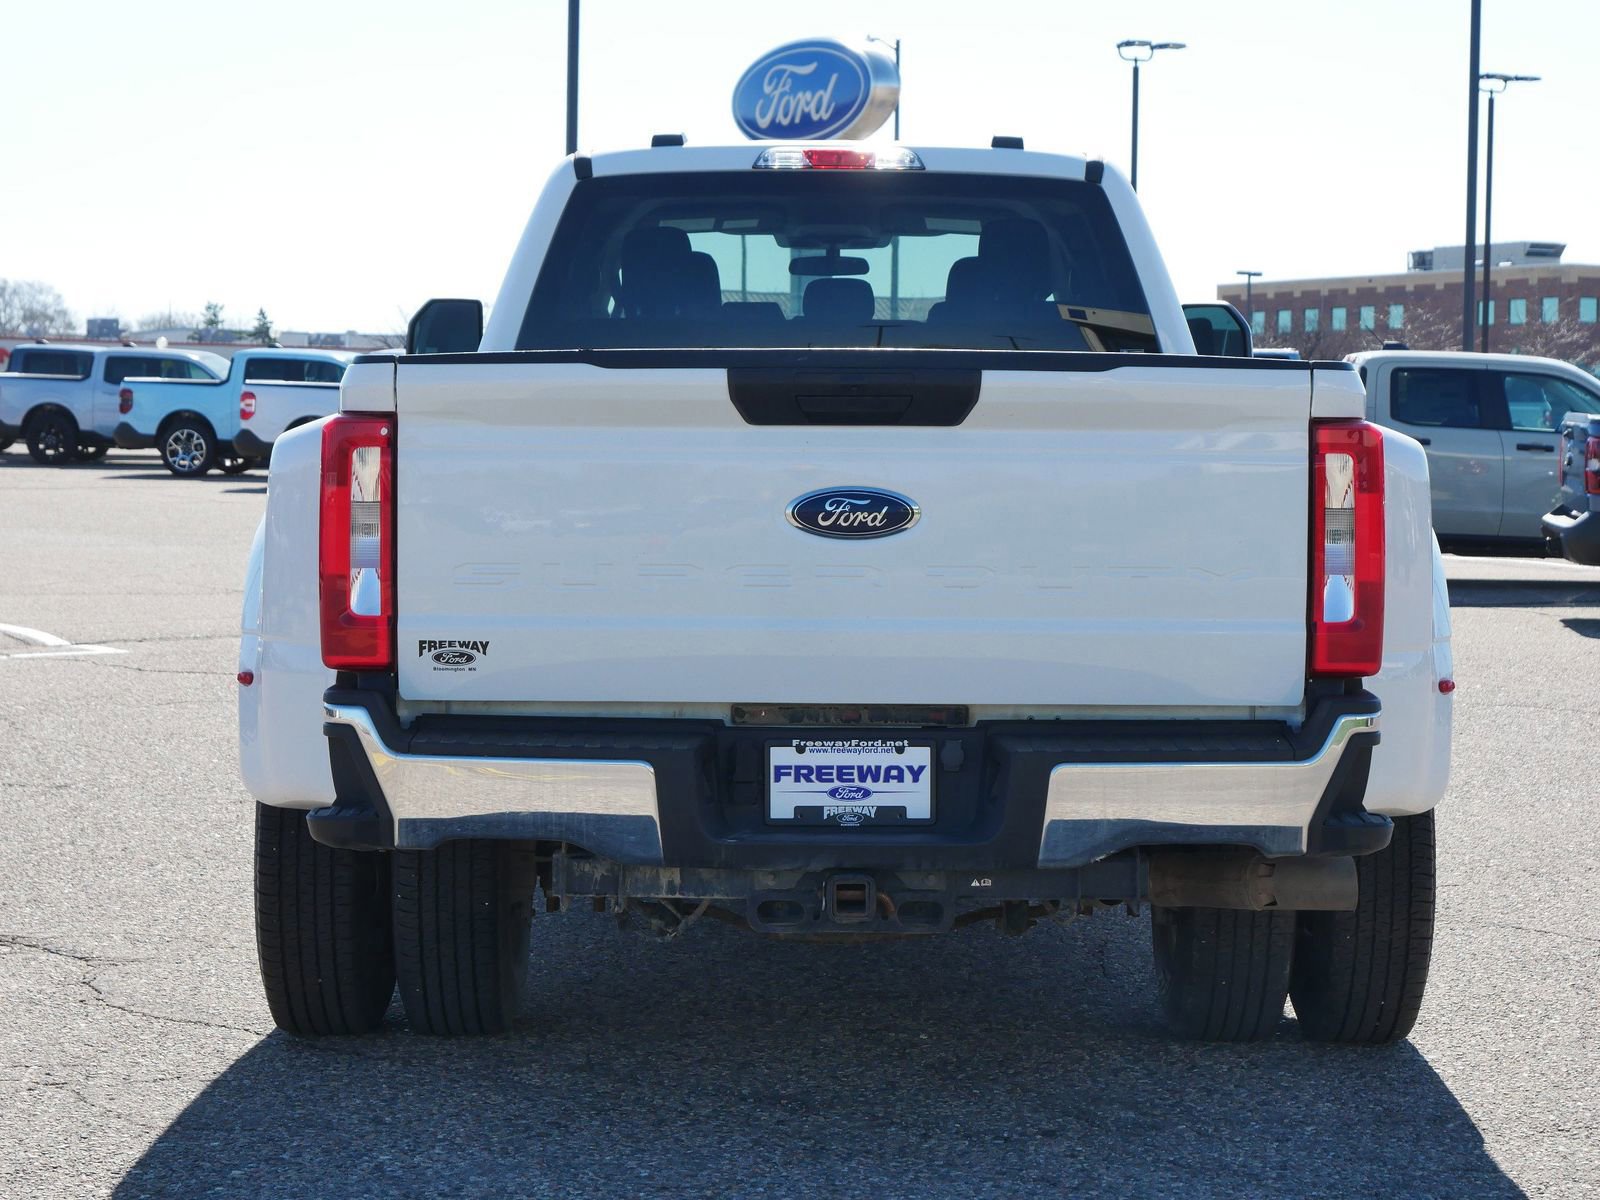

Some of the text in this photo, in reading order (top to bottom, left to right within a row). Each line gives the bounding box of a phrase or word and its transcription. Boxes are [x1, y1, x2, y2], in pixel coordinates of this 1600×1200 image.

[755, 61, 839, 129] Ford
[817, 497, 889, 527] Ford
[418, 640, 490, 658] FREEWAY
[439, 652, 468, 664] Ford
[792, 739, 909, 748] FreewayFord.net
[773, 765, 927, 783] FREEWAY
[835, 787, 864, 799] Ford
[823, 806, 877, 820] FREEWAY
